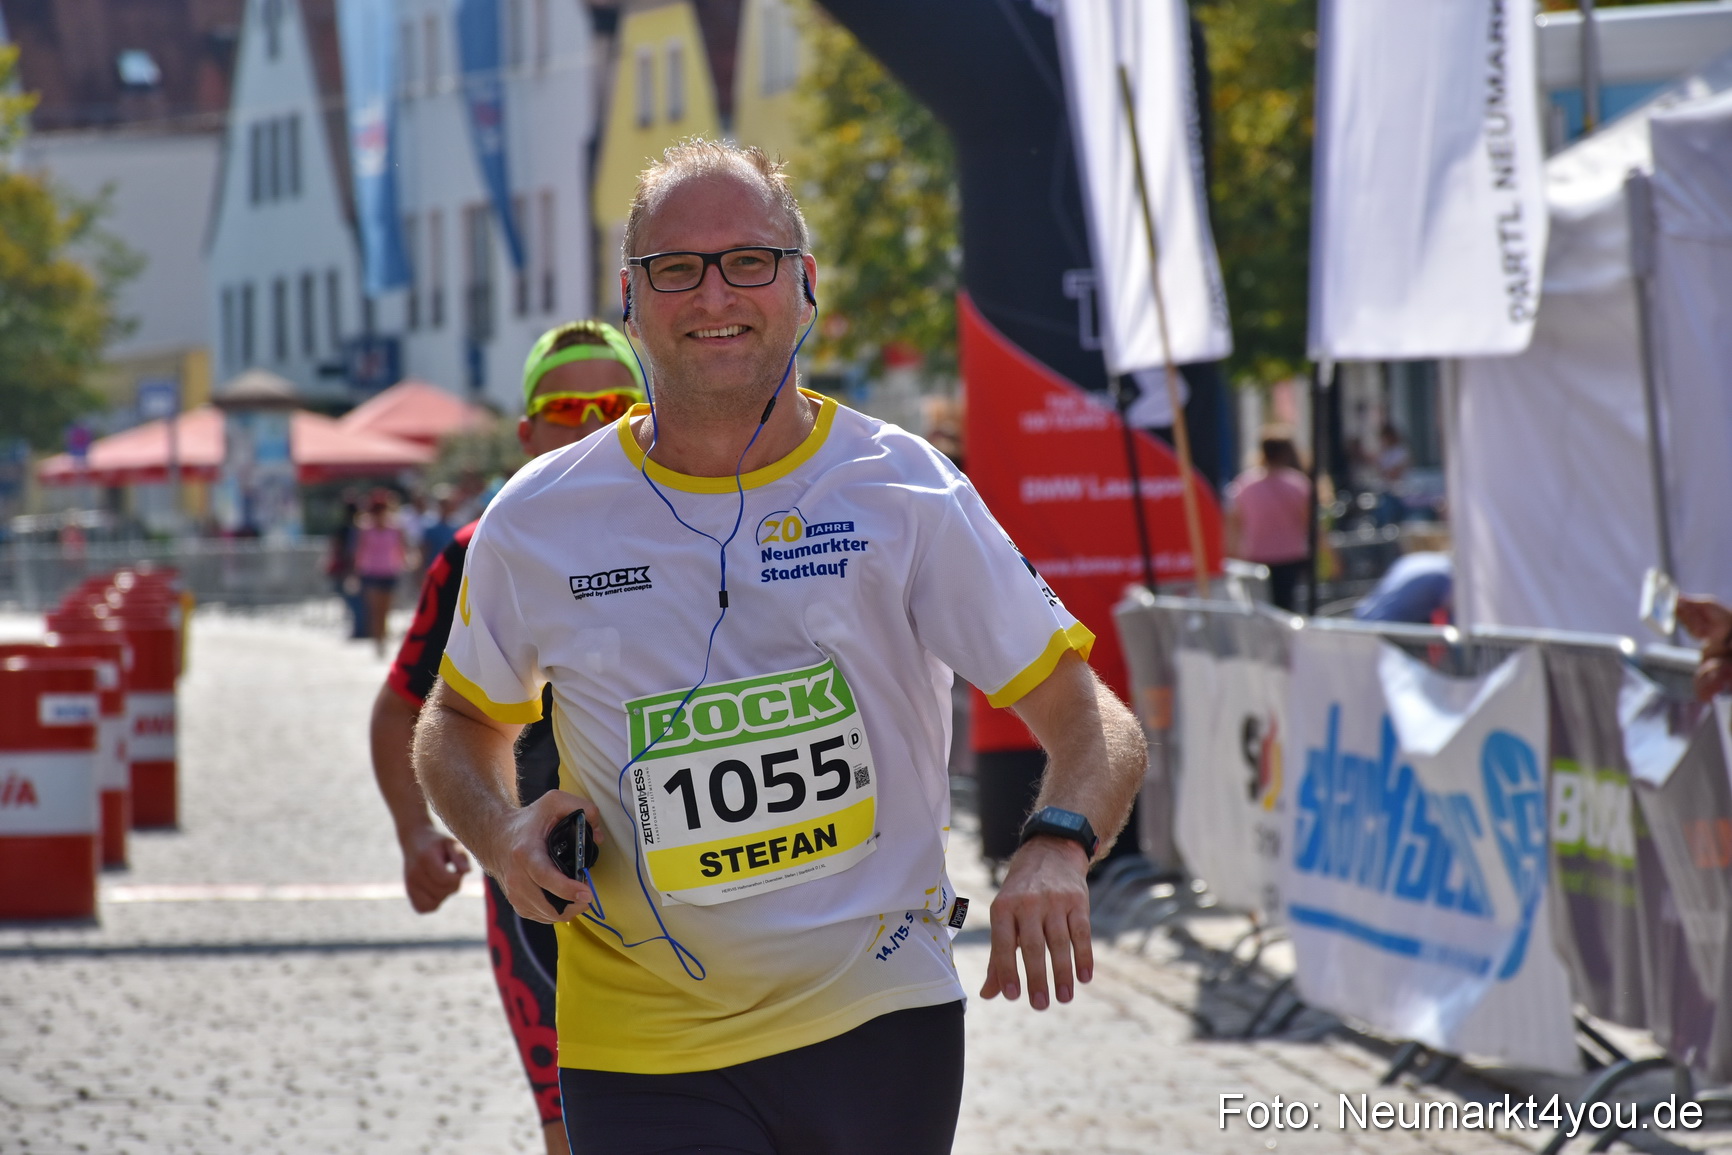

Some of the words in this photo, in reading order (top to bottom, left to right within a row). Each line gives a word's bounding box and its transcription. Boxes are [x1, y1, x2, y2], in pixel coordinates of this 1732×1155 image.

[761, 515, 803, 545] 20
[810, 522, 850, 538] JAHRE
[761, 537, 869, 563] Neumarkter
[569, 566, 652, 594] BOCK
[761, 558, 848, 583] Stadtlauf
[645, 670, 844, 750] BOCK
[663, 735, 851, 831] 1055
[699, 823, 839, 879] STEFAN
